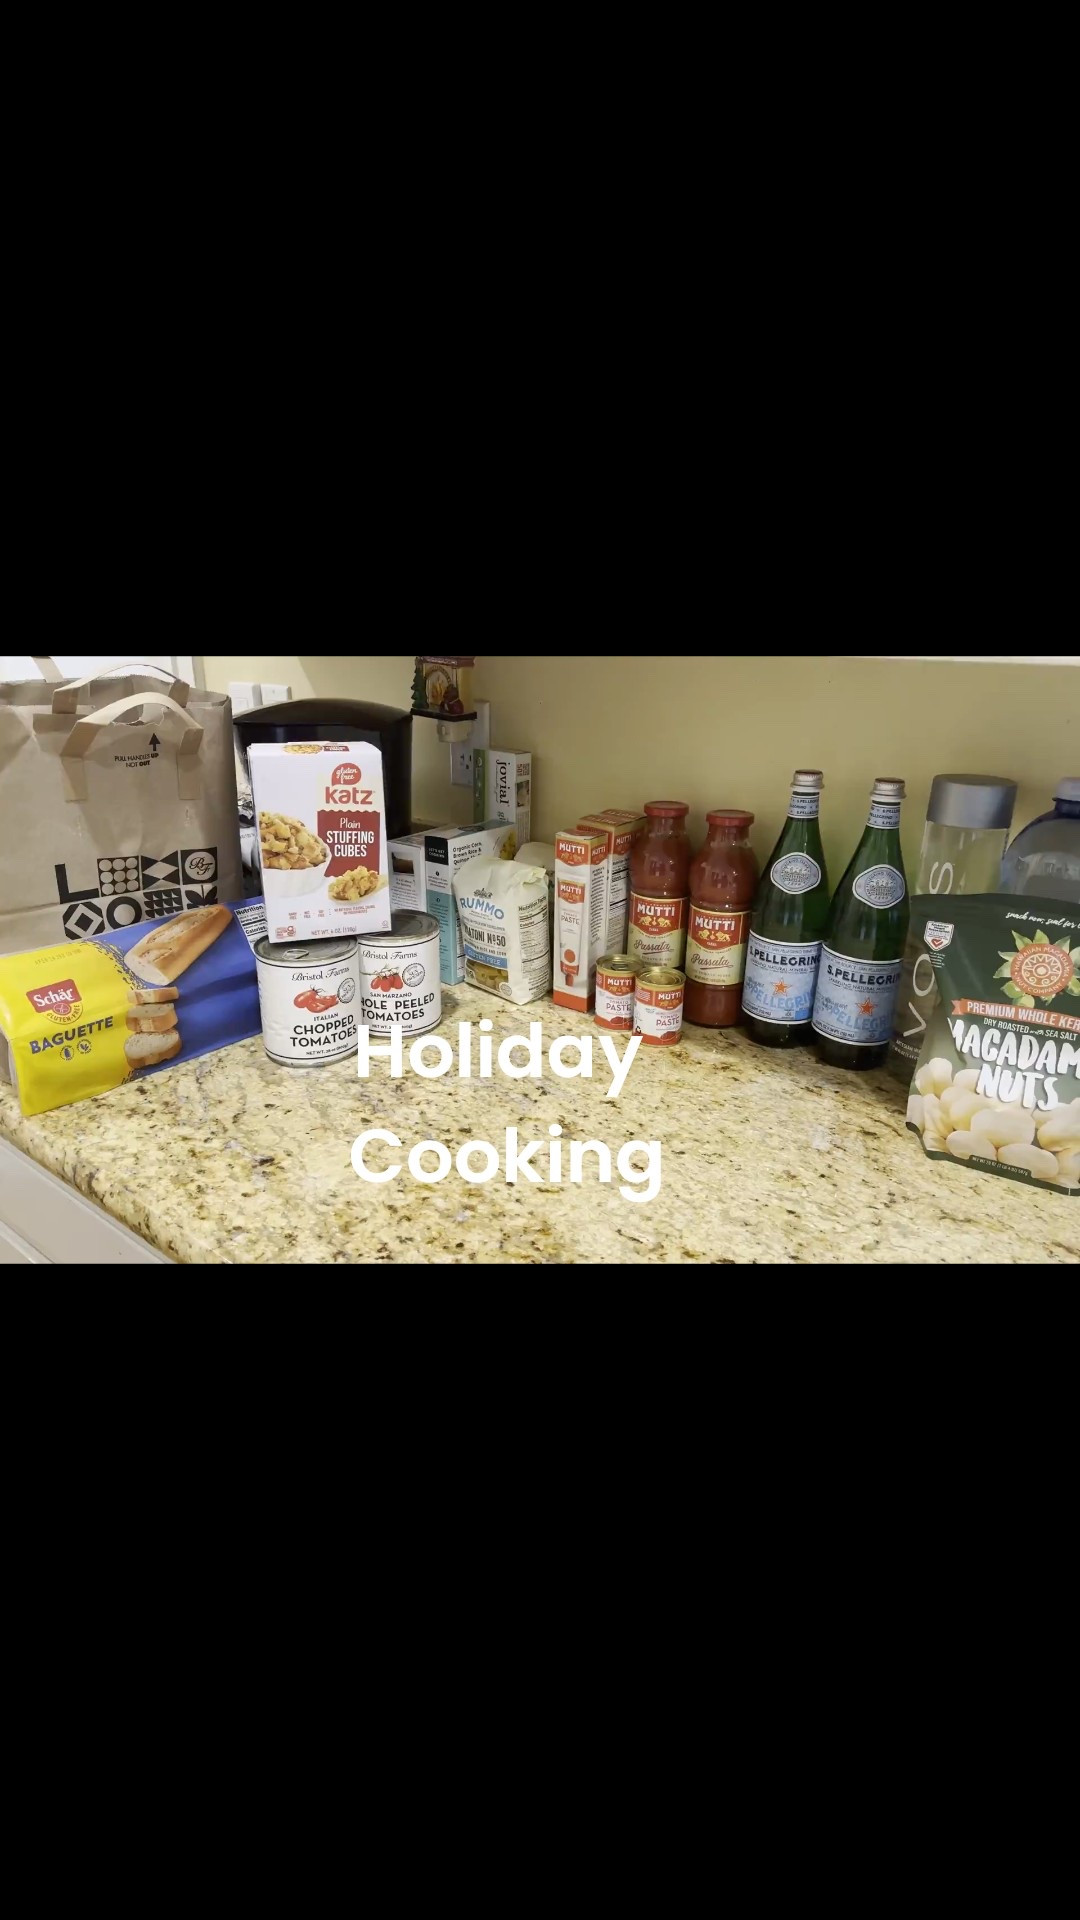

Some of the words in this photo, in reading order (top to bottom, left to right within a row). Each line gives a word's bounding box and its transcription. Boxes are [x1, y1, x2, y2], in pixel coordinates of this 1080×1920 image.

[128, 753, 150, 761] HANDLES
[496, 759, 511, 804] jovial
[325, 786, 373, 805] katz
[339, 817, 361, 829] Plain
[326, 830, 374, 844] STUFFING
[616, 834, 632, 845] MUTTI
[334, 844, 367, 857] CUBES
[452, 844, 471, 853] Organic
[559, 843, 585, 855] MUTTI
[592, 846, 606, 856] MUTTI
[560, 885, 582, 895] MUTTI
[236, 905, 264, 916] Nutrition
[460, 897, 504, 920] RUMMO
[637, 903, 675, 917] MUTTI
[561, 915, 580, 926] PASTE
[695, 916, 735, 930] MUTTI
[633, 940, 671, 951] Passata
[363, 949, 388, 960] Bristol
[390, 951, 418, 960] Farms
[690, 953, 730, 967] Passata
[1014, 946, 1042, 970] HAWAIIAN
[1043, 947, 1070, 977] MACADAMIA
[291, 970, 323, 982] Bristol
[325, 967, 350, 978] Farms
[607, 978, 632, 986] MUTTI
[1027, 982, 1063, 994] COMPANY
[33, 988, 75, 1007] Schär
[361, 997, 387, 1010] HOLE
[395, 992, 435, 1010] PEELED
[658, 991, 681, 1000] MUTTI
[46, 1004, 80, 1023] GLUTEN-FREE
[606, 1003, 632, 1012] PASTE
[967, 1001, 1016, 1019] PREMIUM
[1018, 1008, 1057, 1026] WHOLE
[313, 1012, 339, 1021] ITALIAN
[361, 1008, 425, 1022] TOMATOES
[656, 1015, 680, 1027] PASTE
[293, 1014, 354, 1035] CHOPPED
[984, 1018, 996, 1027] DRY
[997, 1021, 1030, 1034] ROASTED
[1045, 1029, 1058, 1038] SEA
[1060, 1031, 1078, 1041] SALT
[29, 1016, 114, 1054] BAGUETTE
[290, 1024, 357, 1047] TOMATOES
[976, 1063, 1059, 1112] NUTS
